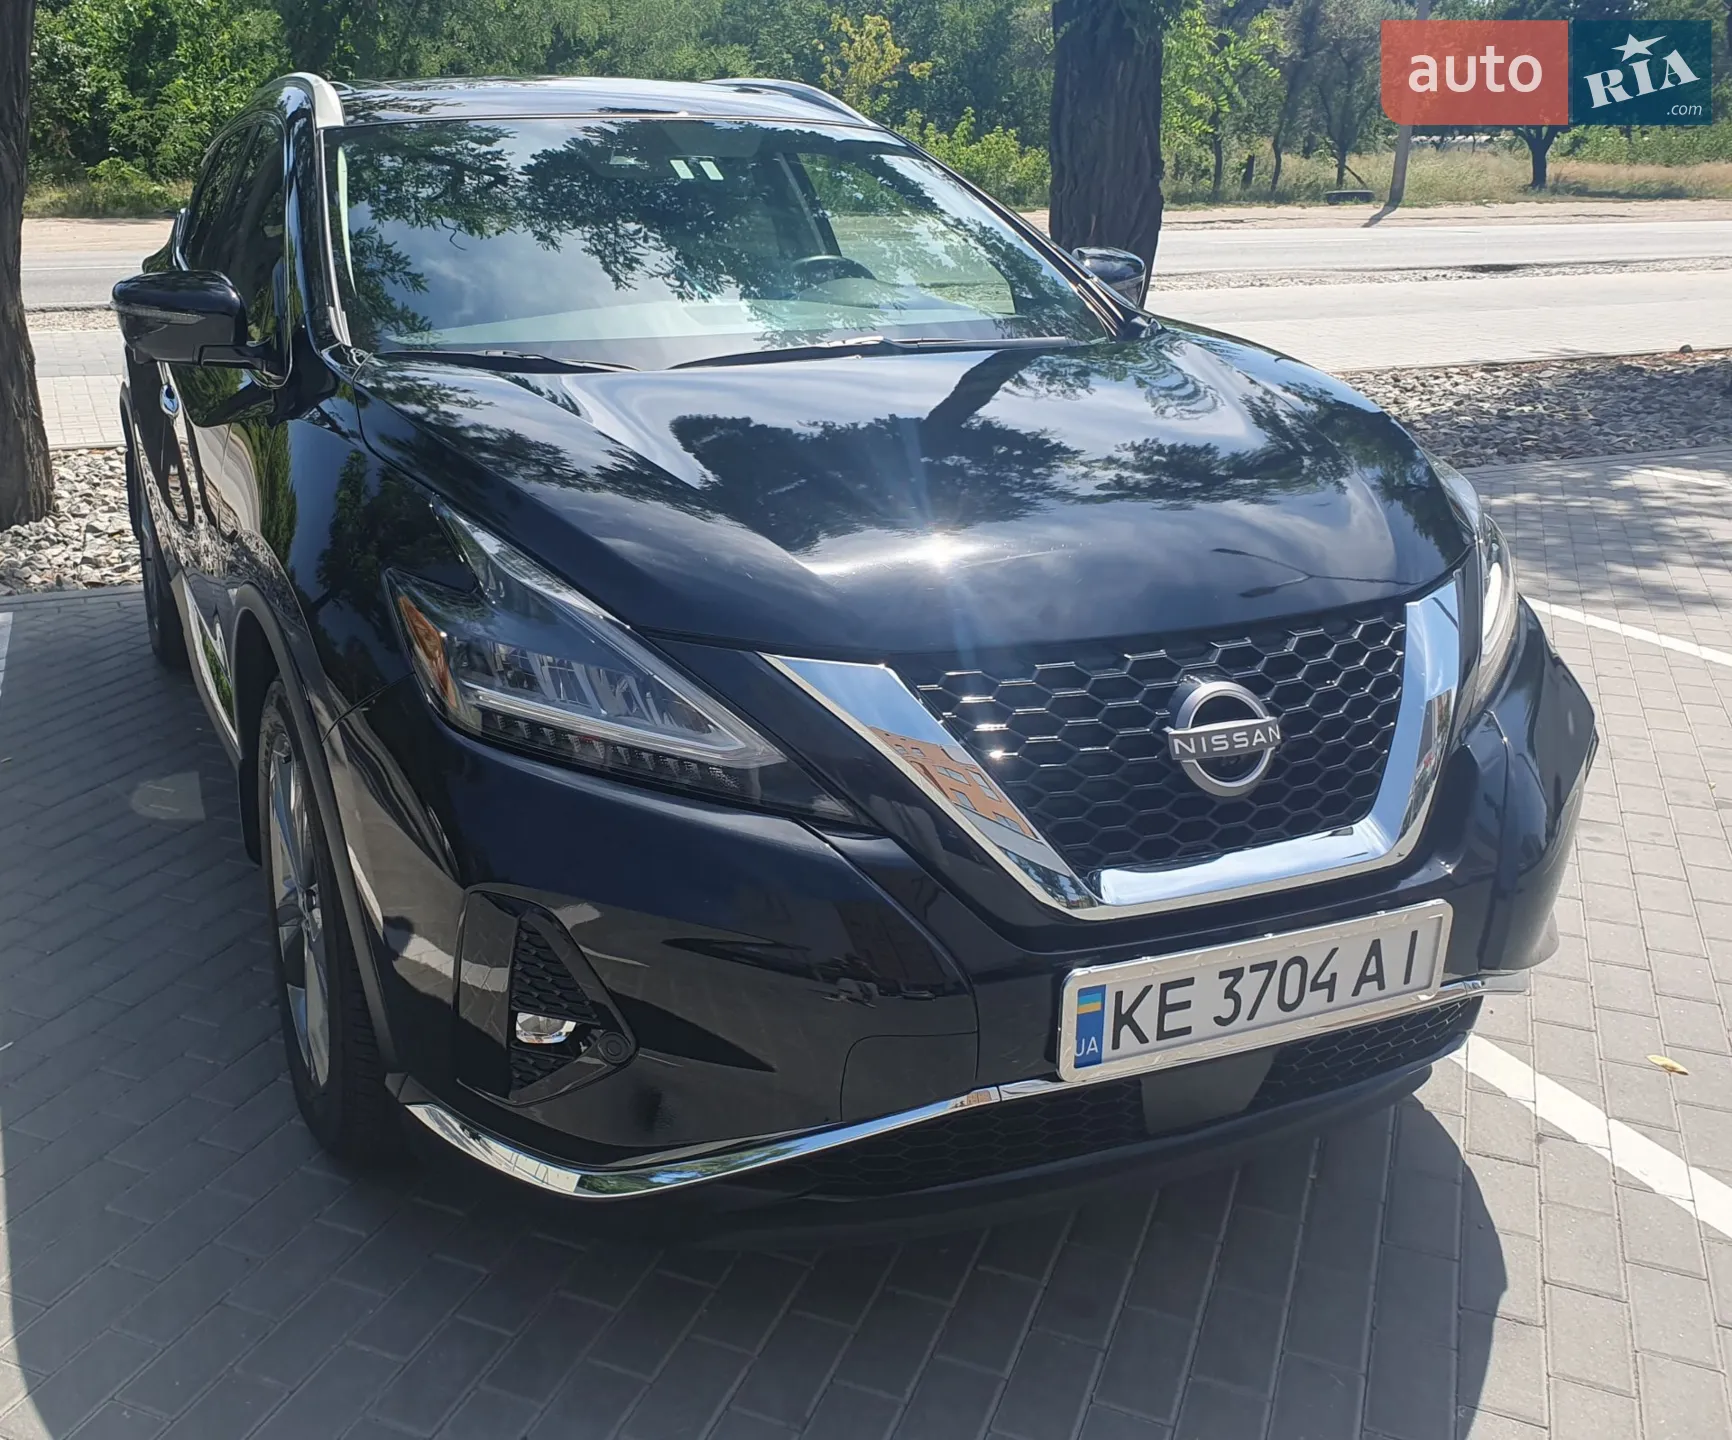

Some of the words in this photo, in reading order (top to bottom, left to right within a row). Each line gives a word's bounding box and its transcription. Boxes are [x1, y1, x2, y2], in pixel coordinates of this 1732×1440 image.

[1173, 723, 1281, 755] NISSAN
[1111, 976, 1195, 1050] KE
[1212, 946, 1340, 1027] 3704
[1075, 1036, 1099, 1057] UA
